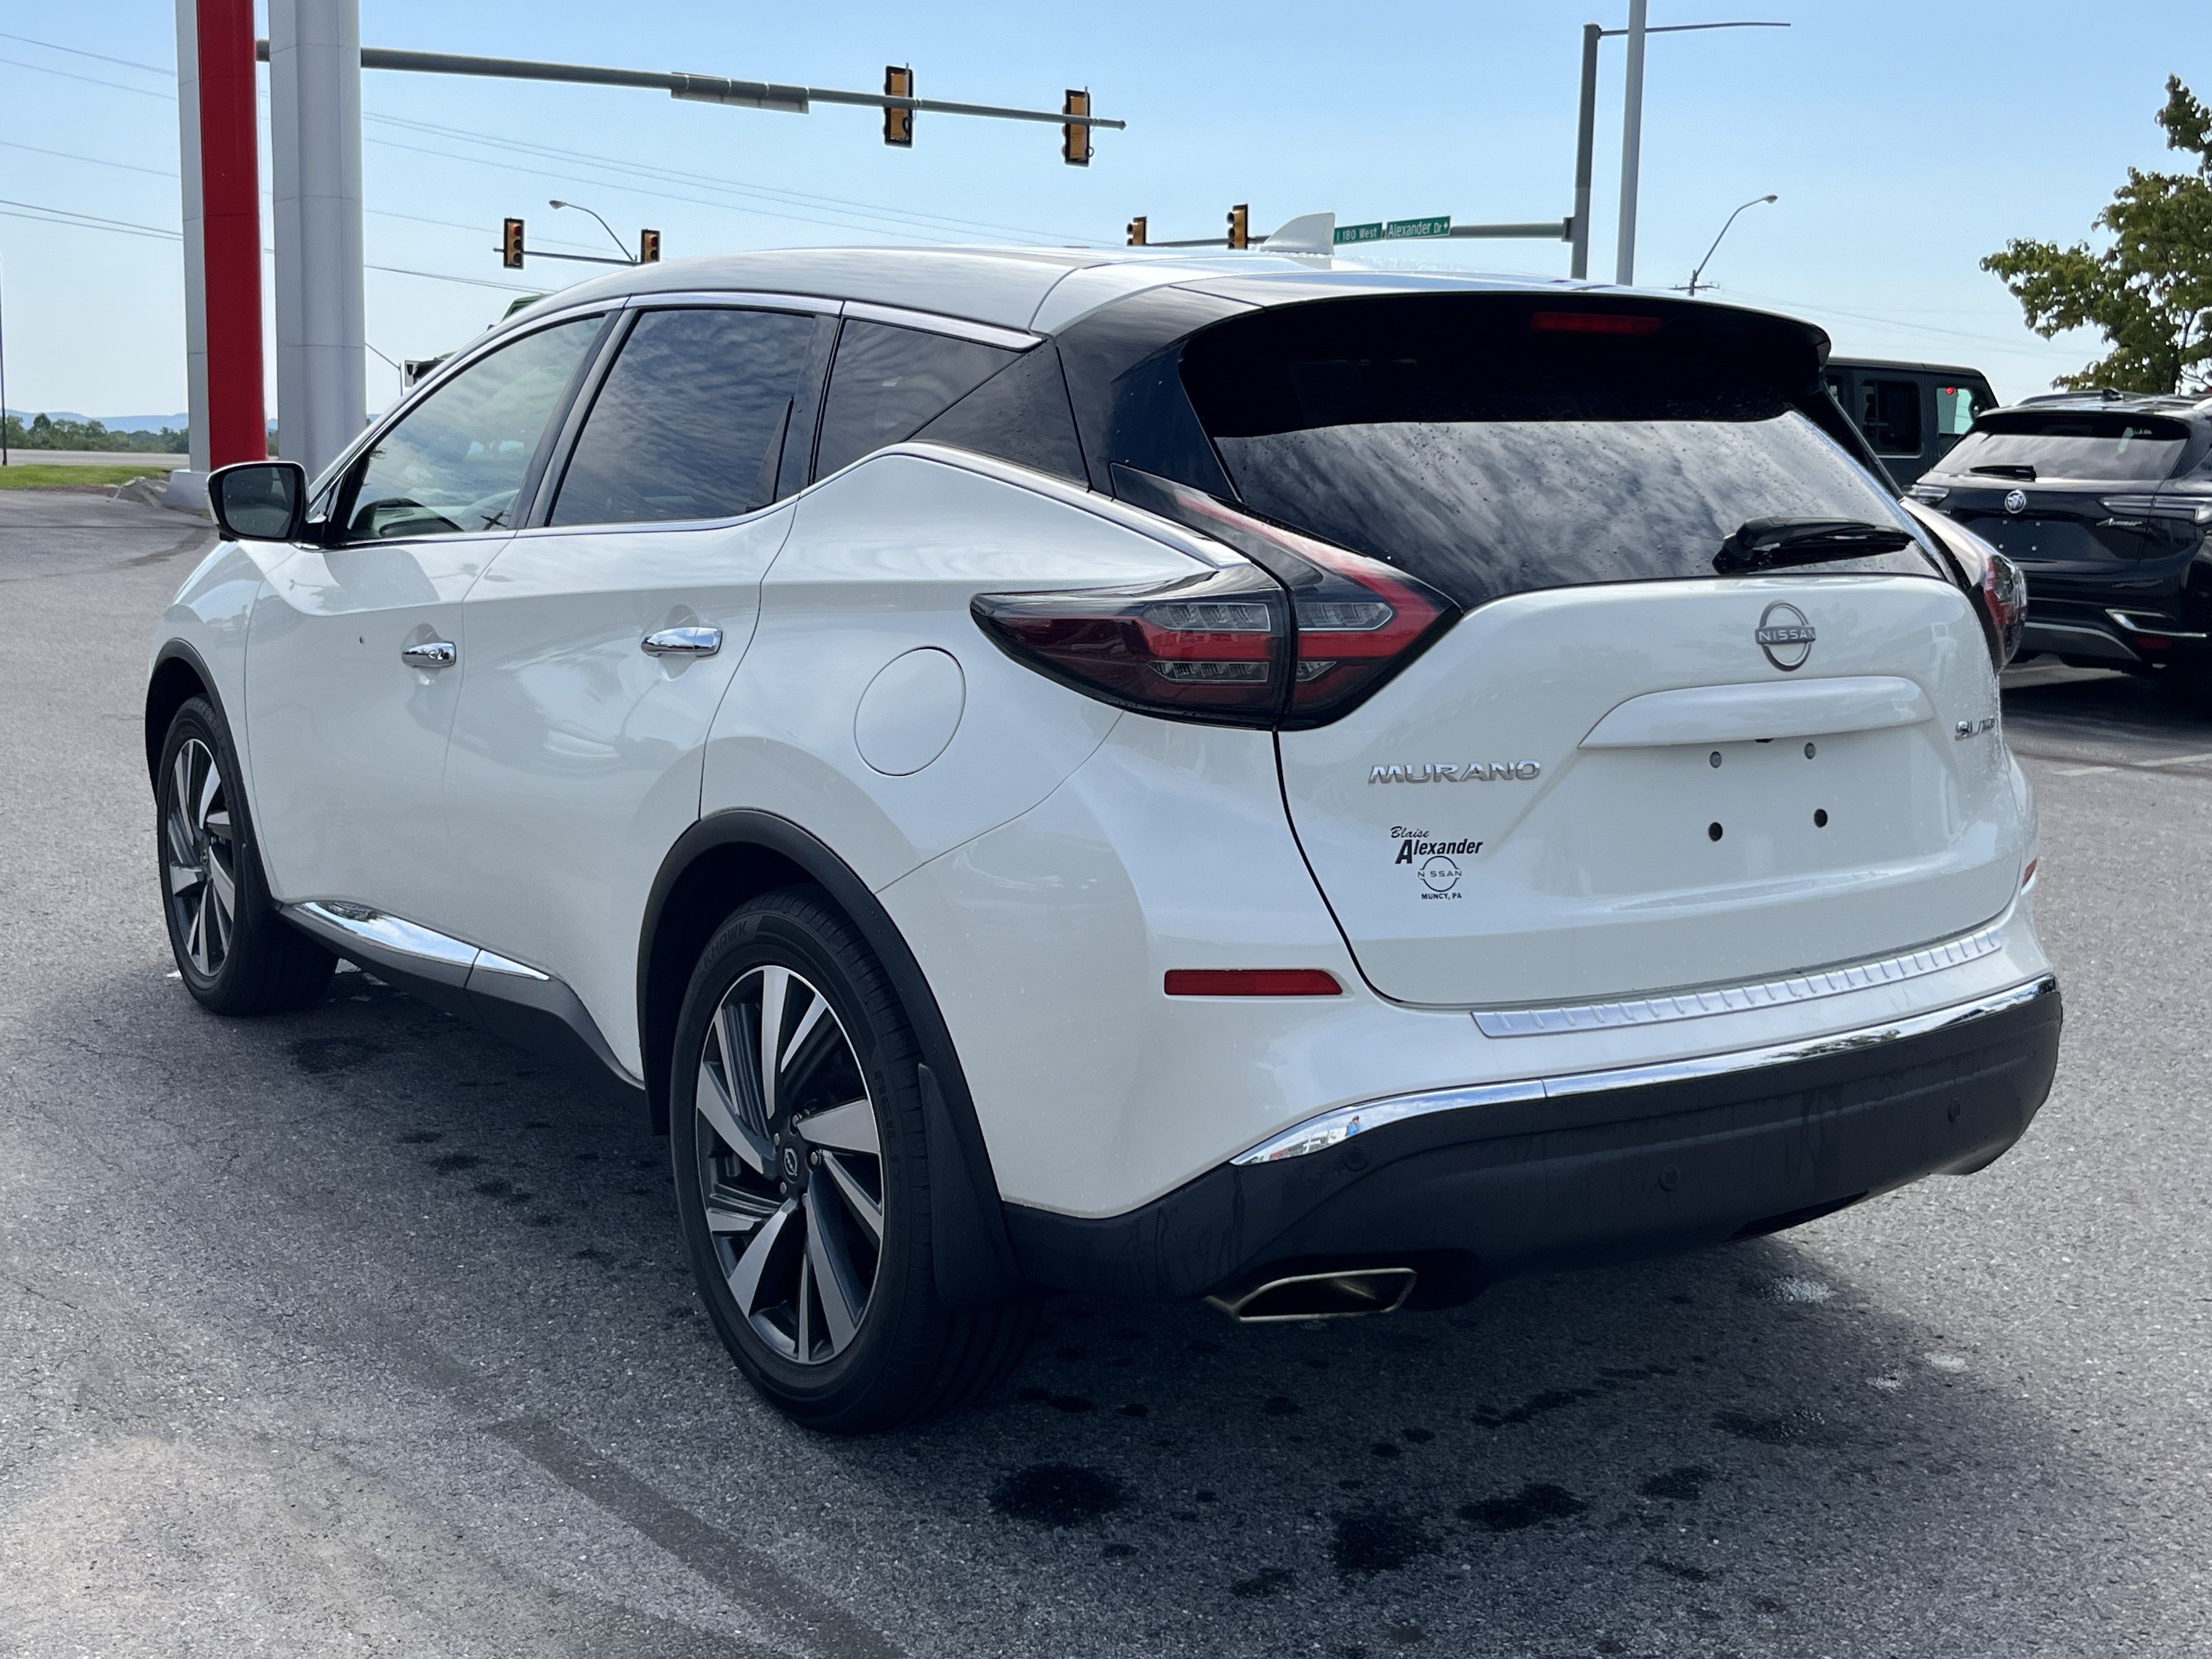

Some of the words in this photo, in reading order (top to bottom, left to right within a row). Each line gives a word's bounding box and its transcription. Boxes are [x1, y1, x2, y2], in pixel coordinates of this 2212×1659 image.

[1342, 229, 1356, 241] 180
[1359, 228, 1377, 239] West
[1387, 221, 1431, 238] Alexander
[1434, 222, 1442, 234] Dr
[1758, 629, 1815, 641] NISSAN
[1368, 759, 1541, 786] MURANO
[1390, 826, 1430, 838] Blaise
[1395, 838, 1483, 864] Alexander
